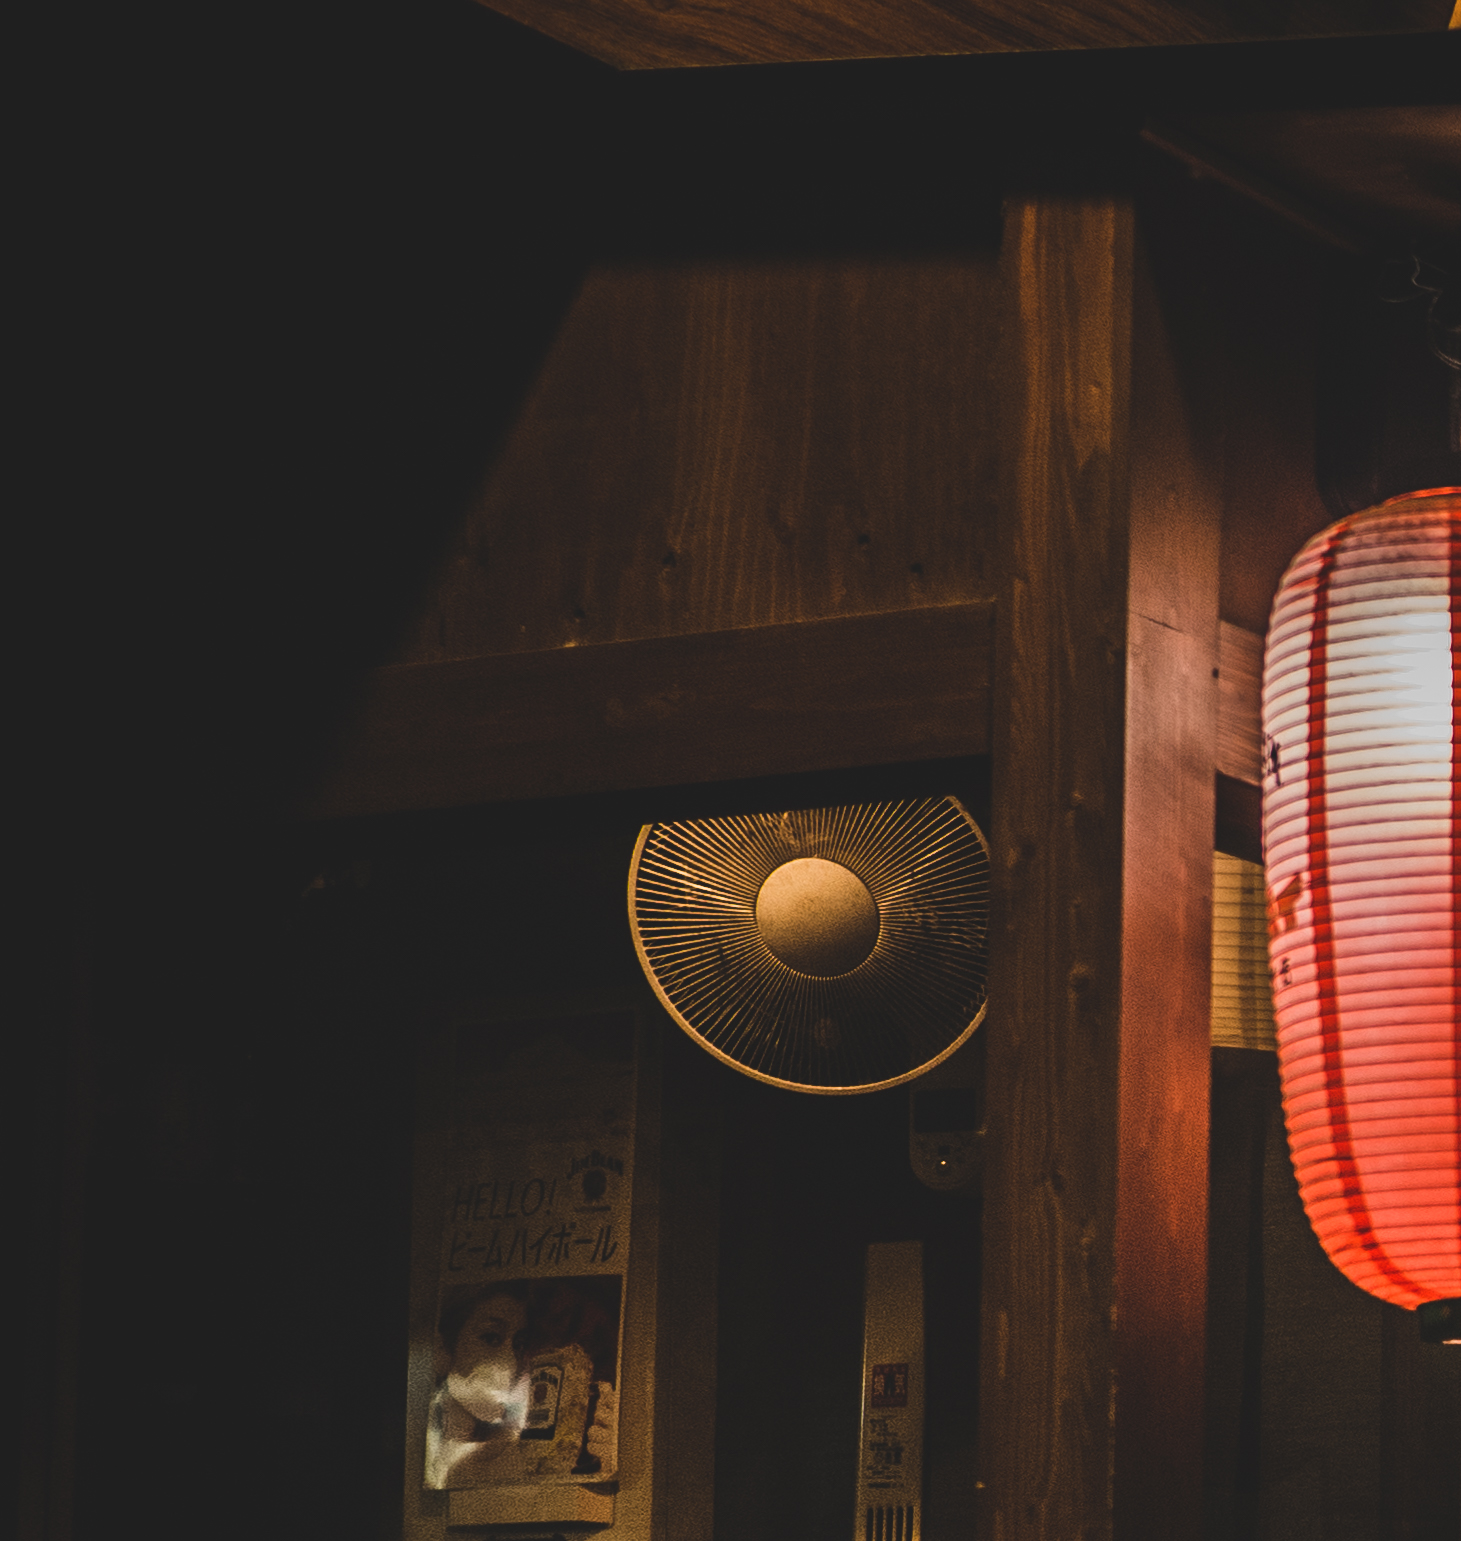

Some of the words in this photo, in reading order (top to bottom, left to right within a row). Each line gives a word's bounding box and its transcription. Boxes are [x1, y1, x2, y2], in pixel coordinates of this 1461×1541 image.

[450, 1178, 557, 1223] HELLO!
[447, 1222, 618, 1273] ビームハイボール
